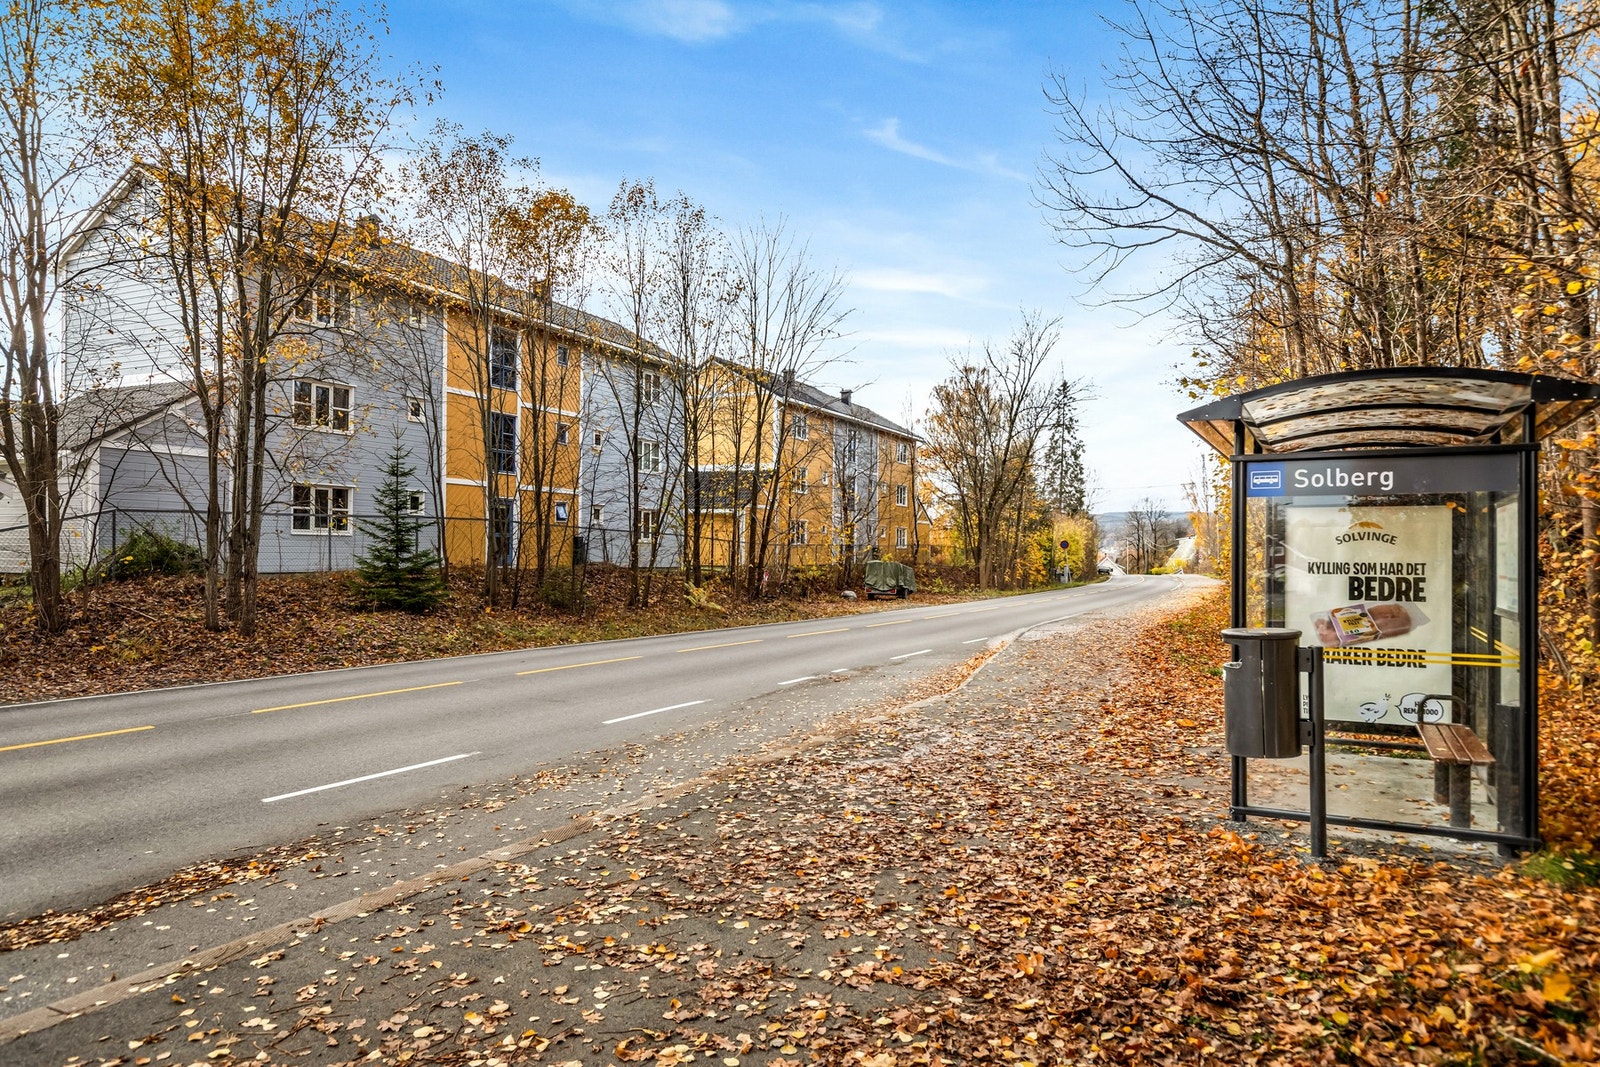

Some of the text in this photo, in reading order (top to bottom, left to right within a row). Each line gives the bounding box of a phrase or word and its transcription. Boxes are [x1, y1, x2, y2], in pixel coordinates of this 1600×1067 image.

[1294, 468, 1394, 491] Solberg
[1335, 531, 1398, 546] SOLVINGE
[1307, 561, 1427, 576] KYLLING SOM HAR DET
[1348, 575, 1427, 602] BEDRE
[1376, 647, 1427, 668] BEDRE
